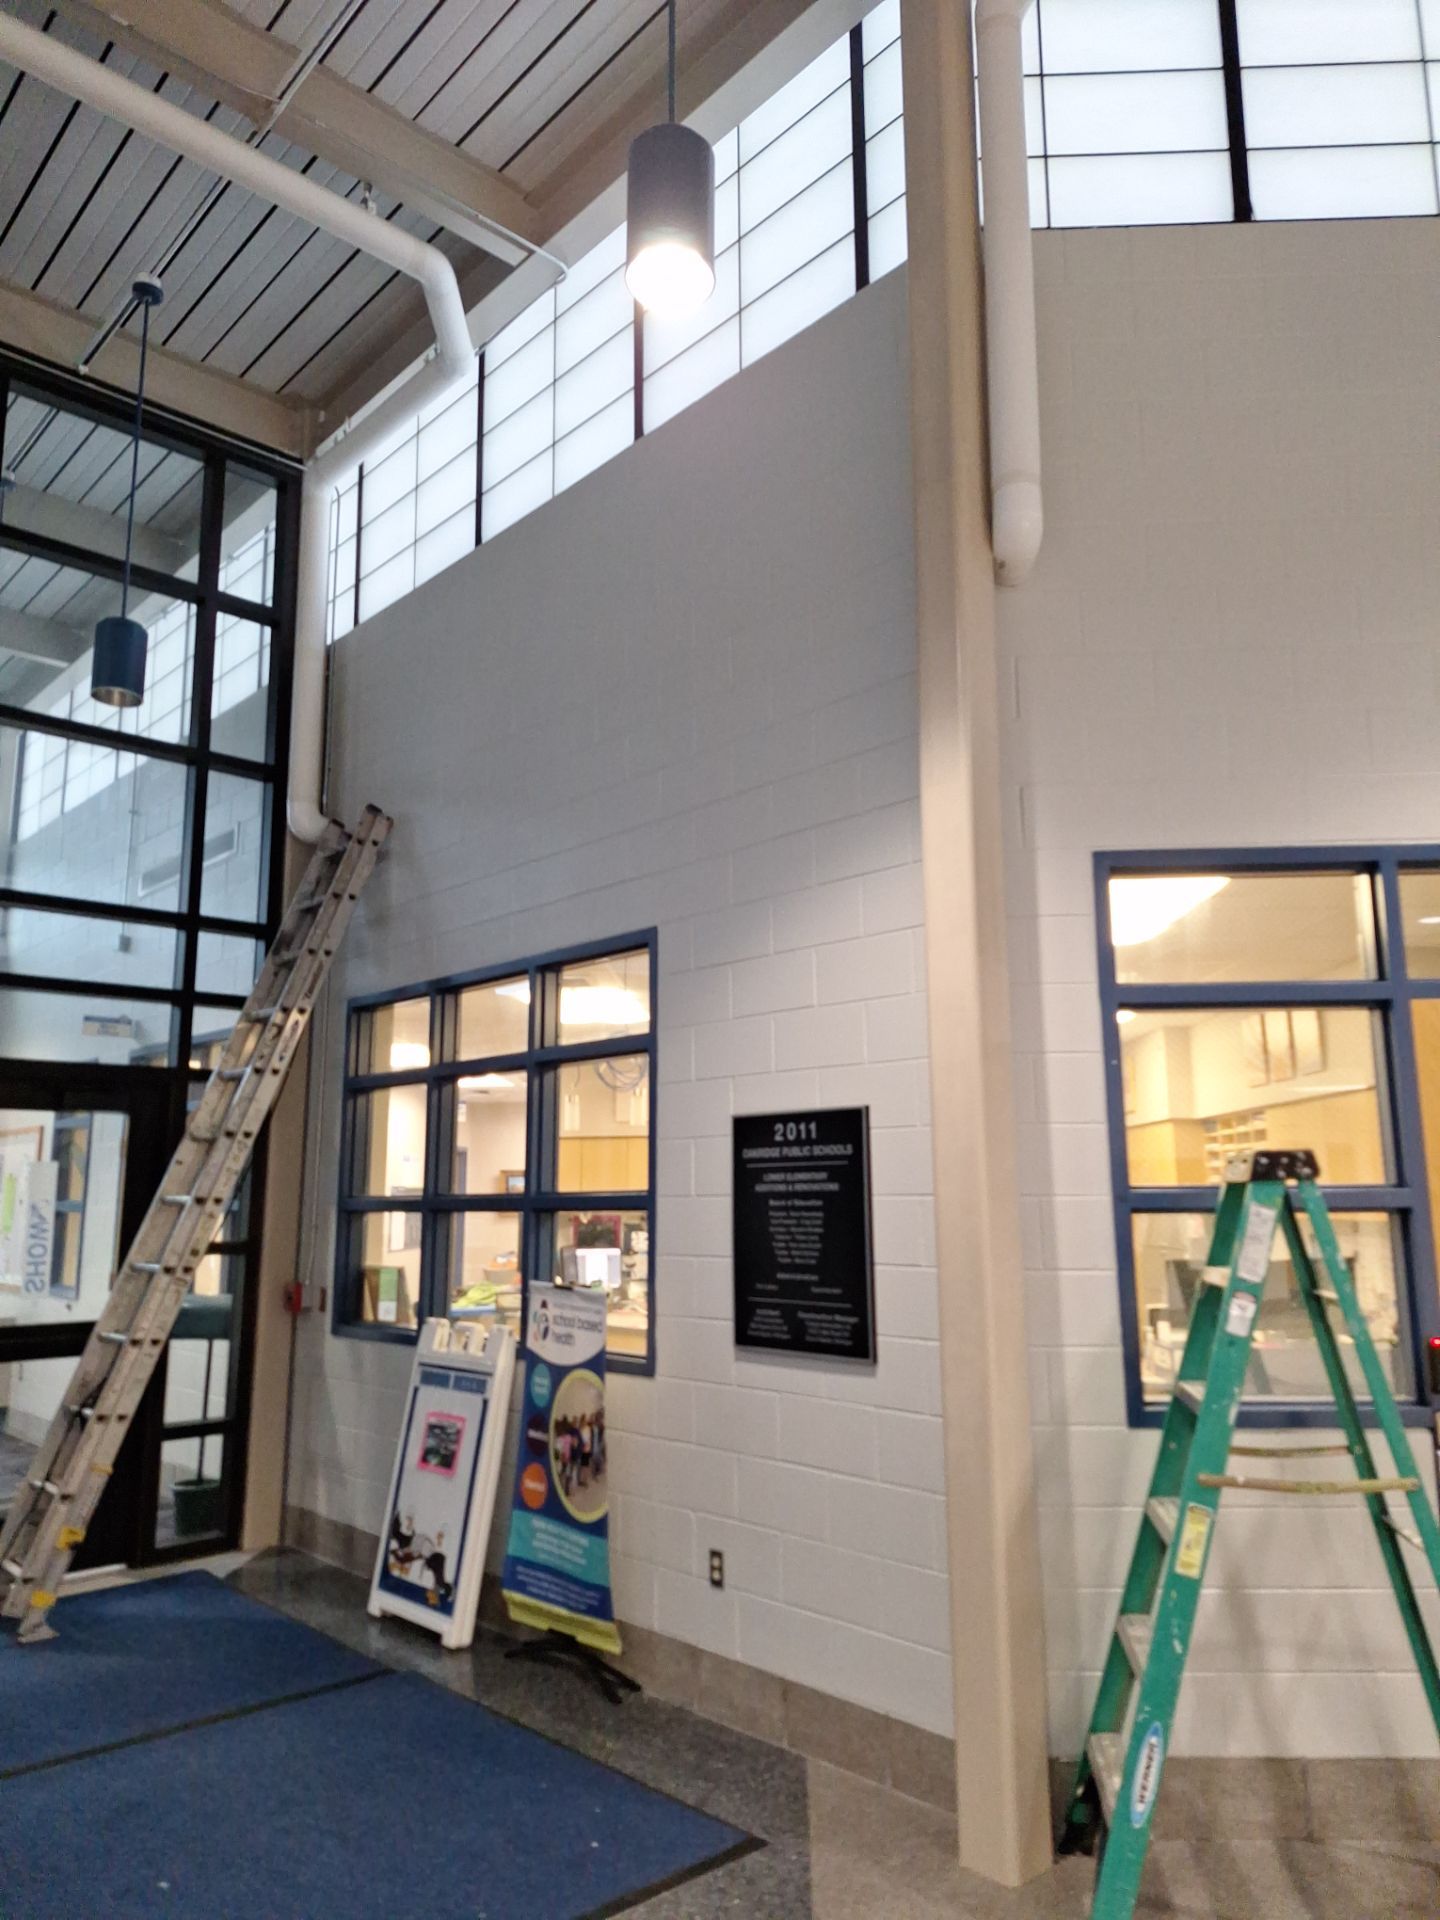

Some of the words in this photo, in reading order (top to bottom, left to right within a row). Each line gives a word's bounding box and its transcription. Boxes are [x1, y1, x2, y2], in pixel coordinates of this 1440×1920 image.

[774, 1121, 817, 1141] 2011
[782, 1145, 811, 1158] PUBLIC
[812, 1143, 853, 1156] SCHOOLS
